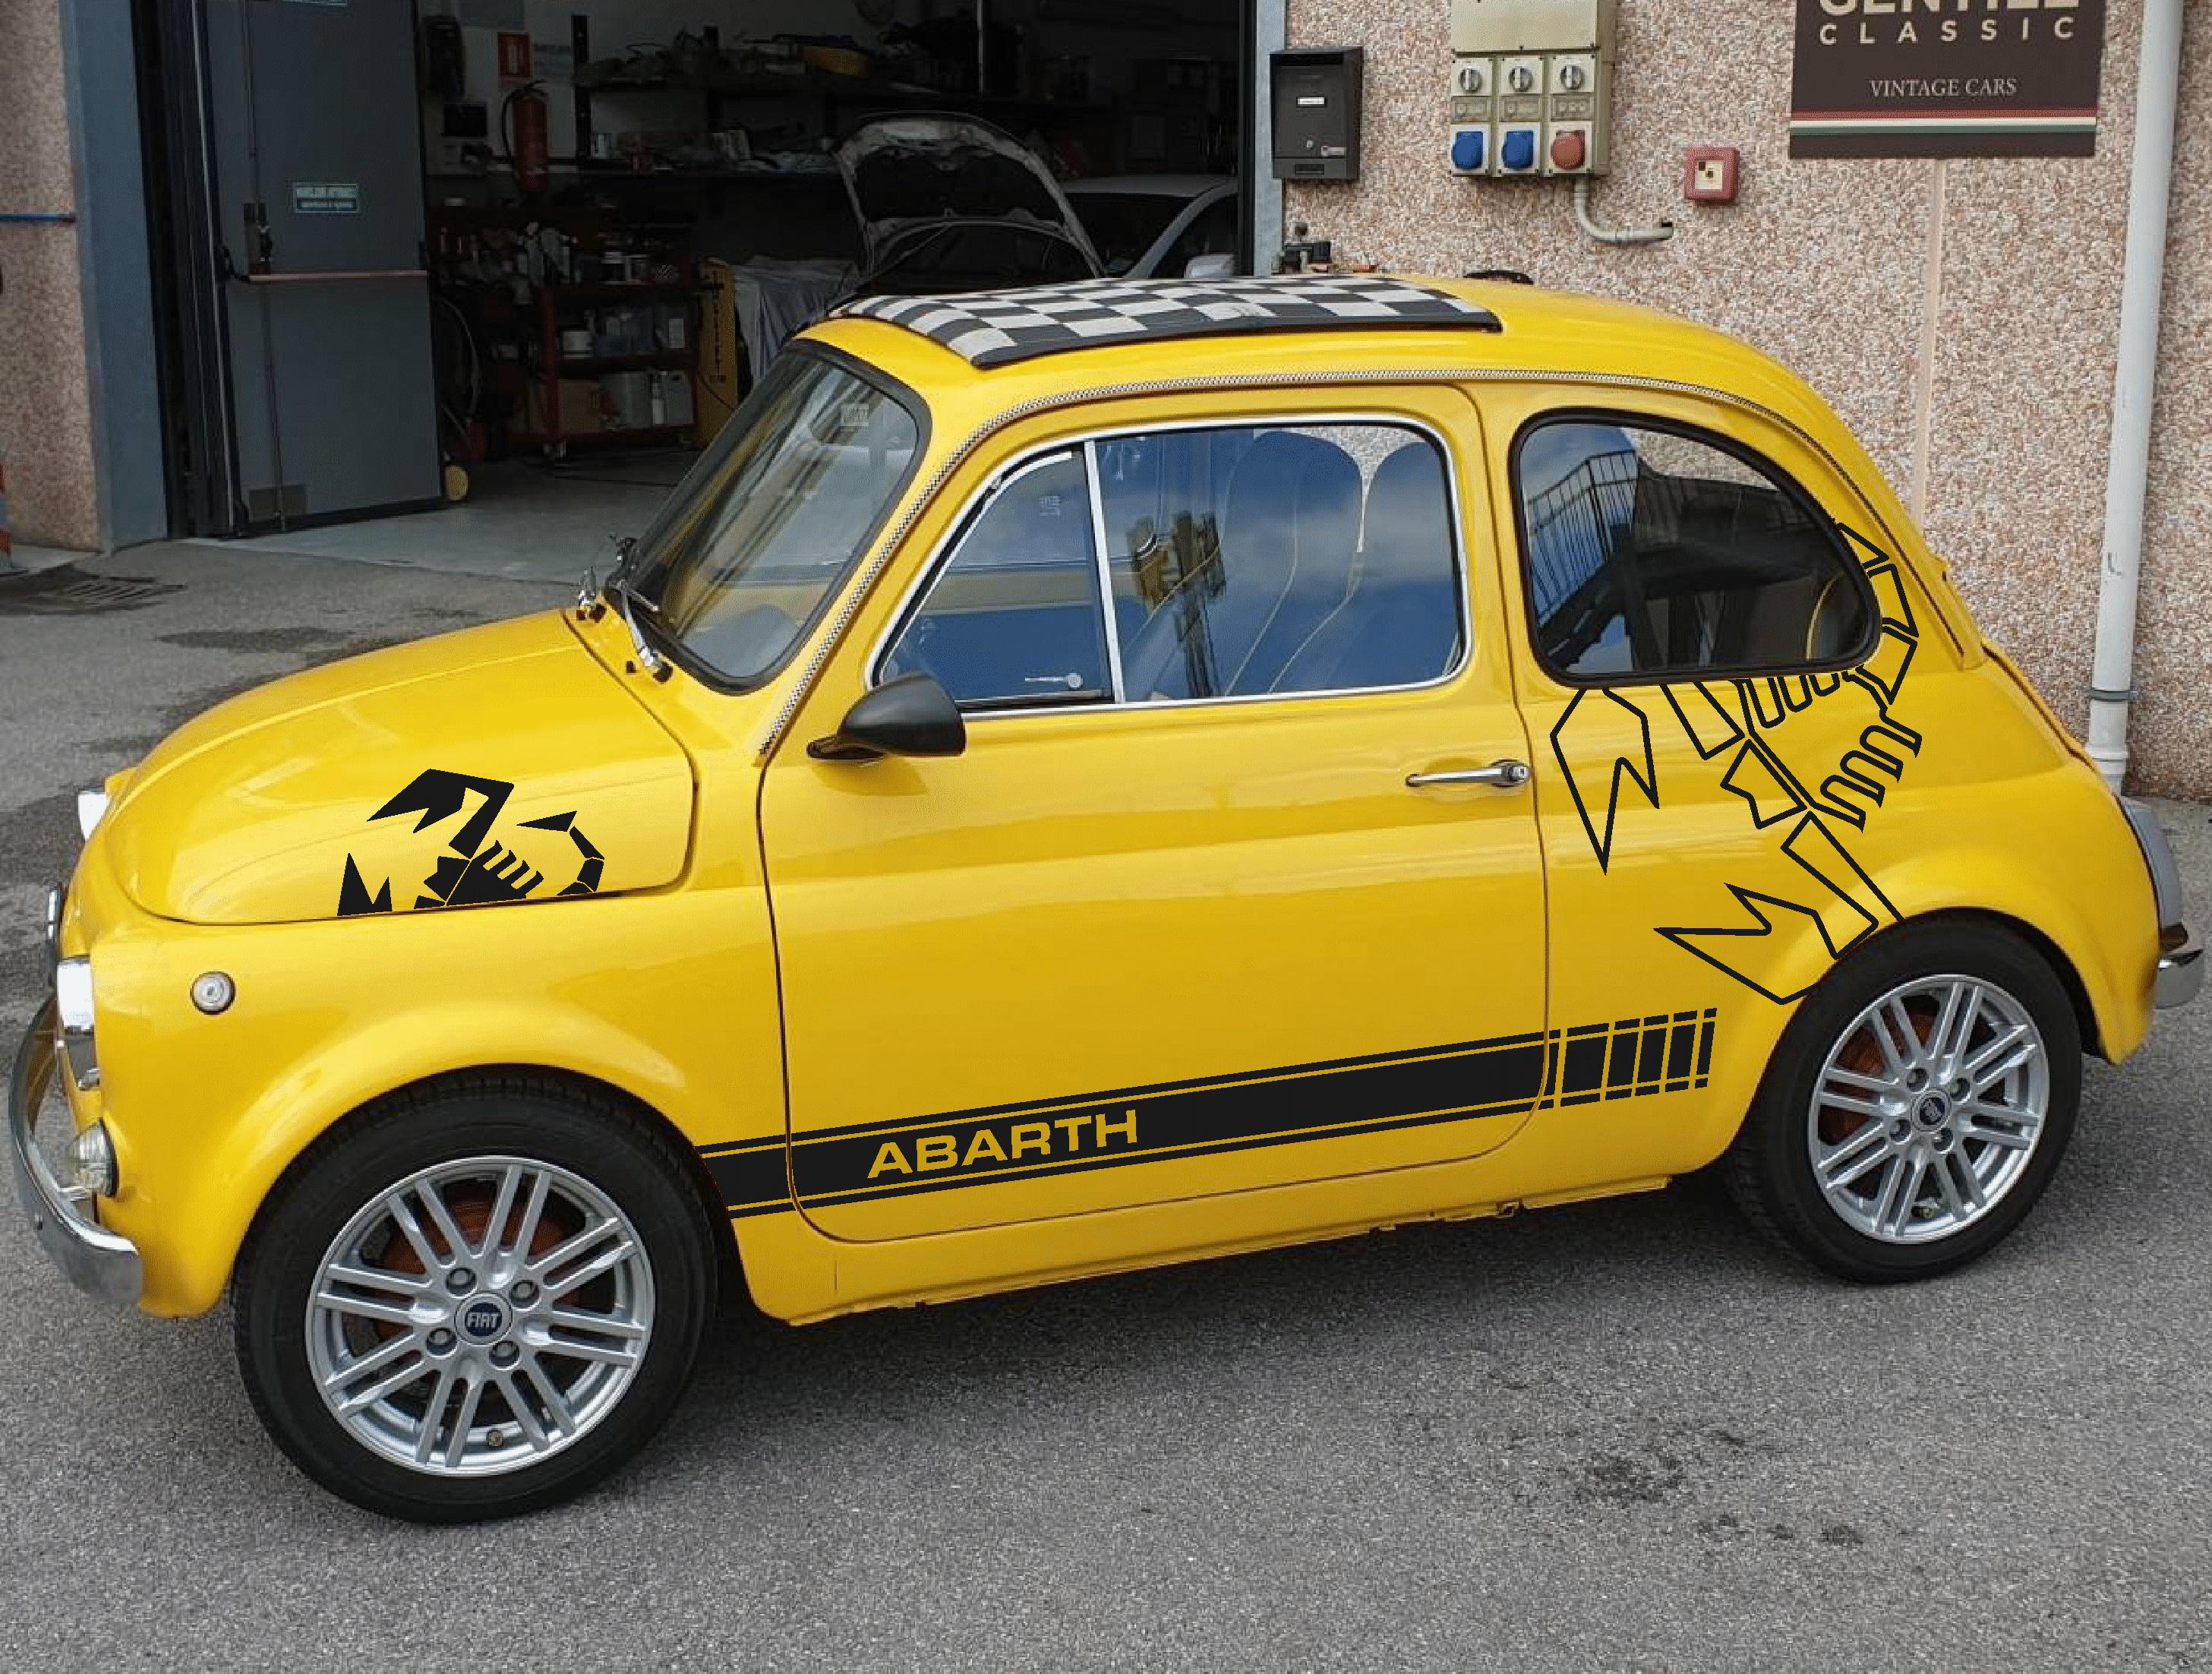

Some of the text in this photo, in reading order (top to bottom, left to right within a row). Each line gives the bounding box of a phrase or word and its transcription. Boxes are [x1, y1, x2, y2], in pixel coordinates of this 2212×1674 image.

[1819, 17, 2075, 46] CLASSIC
[1869, 78, 2017, 96] VINTAGE CARS
[867, 1109, 1138, 1179] ABARTH
[467, 1312, 499, 1328] FIAT
